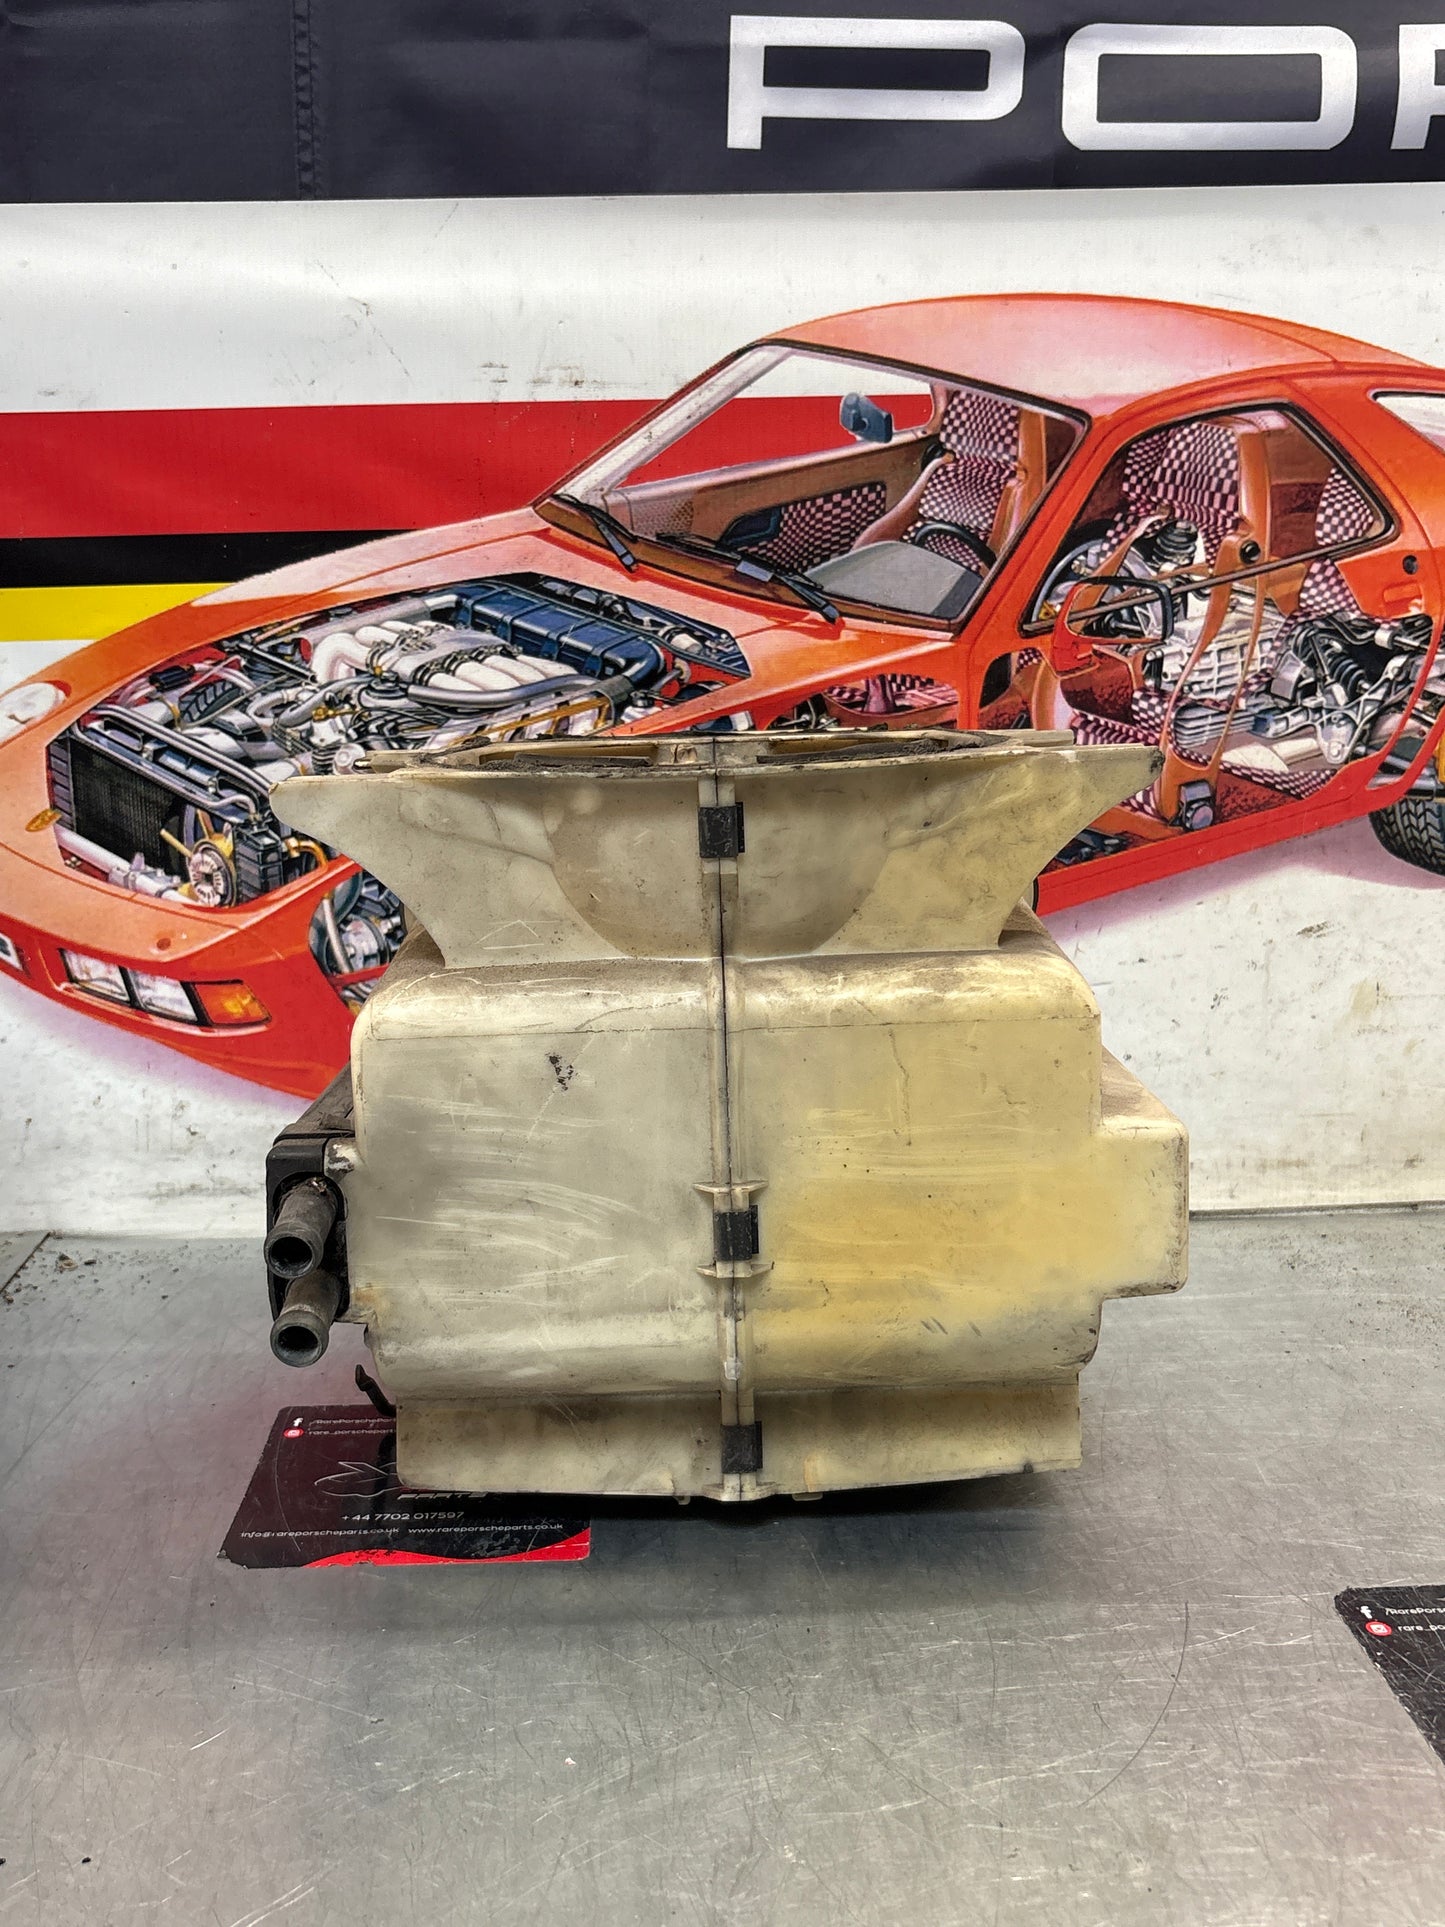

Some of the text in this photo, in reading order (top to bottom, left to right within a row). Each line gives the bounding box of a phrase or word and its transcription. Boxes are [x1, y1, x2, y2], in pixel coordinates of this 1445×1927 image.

[727, 14, 1445, 151] PO
[374, 1513, 410, 1521] 7702
[413, 1511, 464, 1520] 017597
[408, 1523, 563, 1534] www.rareporscheparts.co.uk
